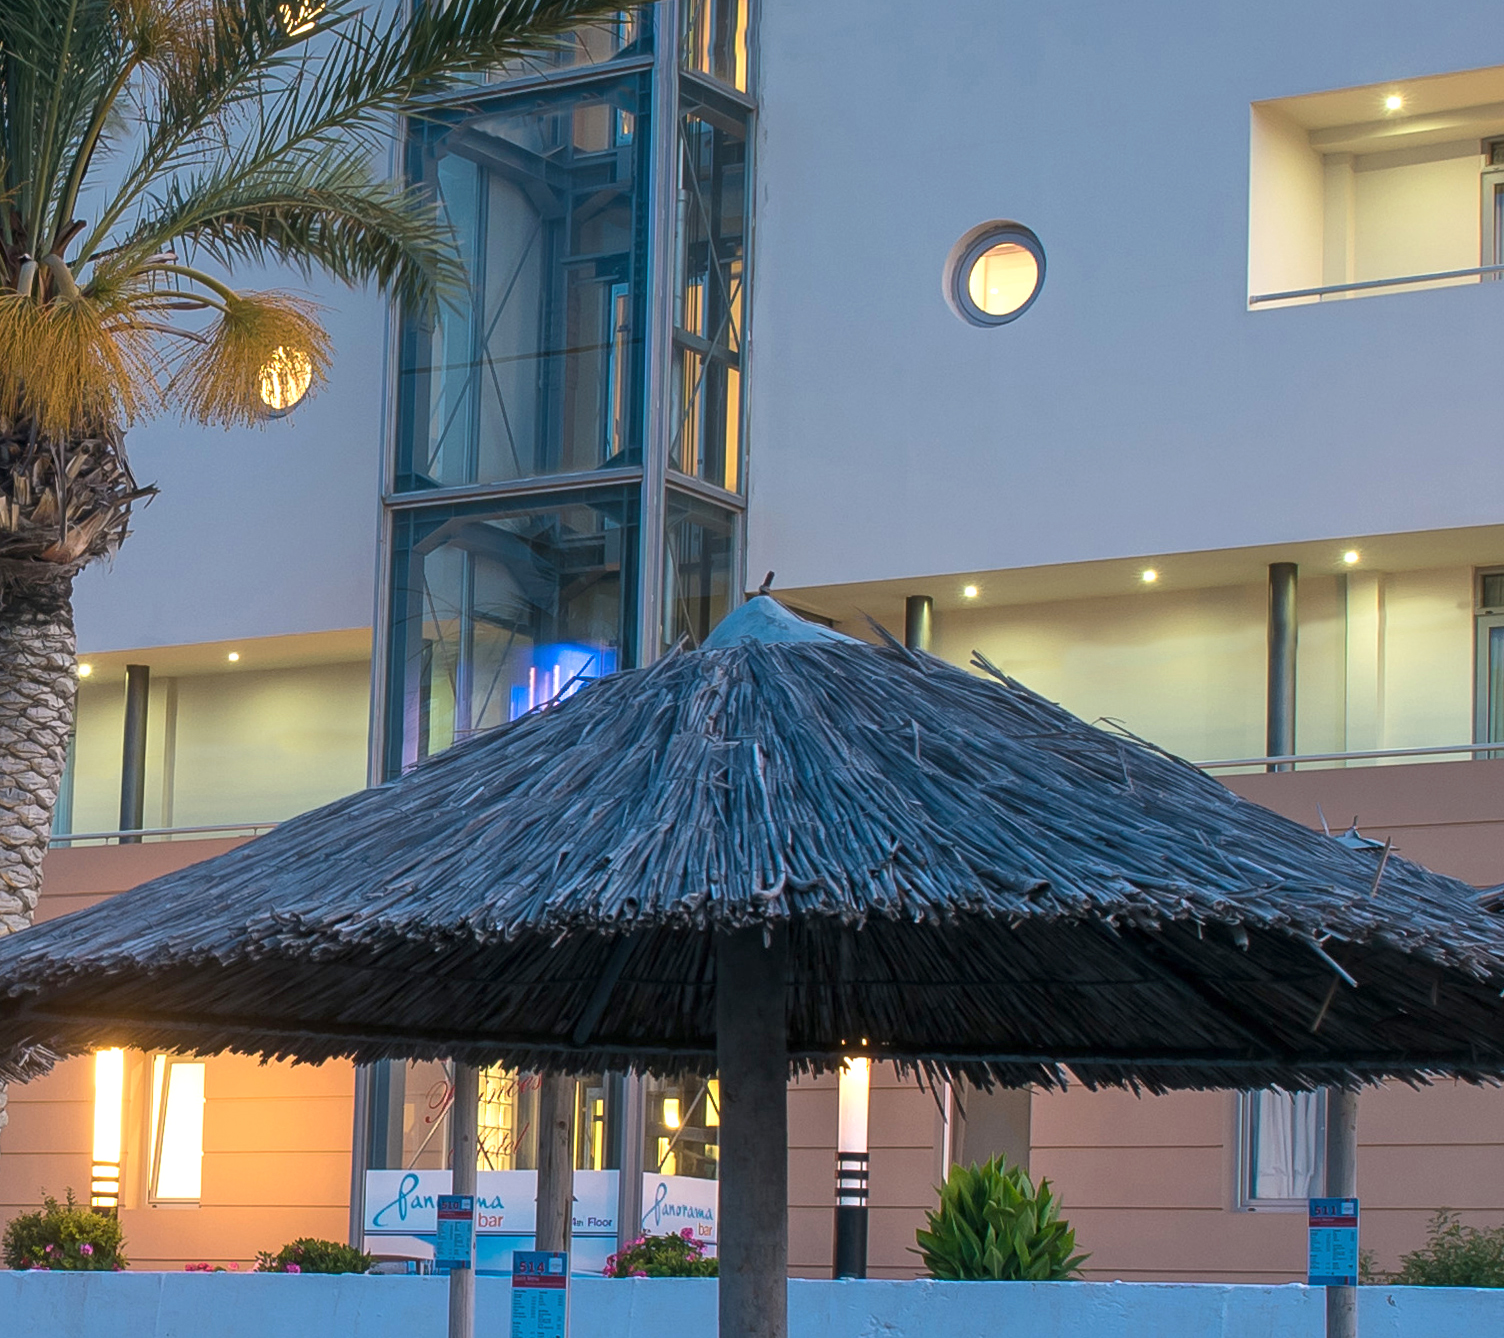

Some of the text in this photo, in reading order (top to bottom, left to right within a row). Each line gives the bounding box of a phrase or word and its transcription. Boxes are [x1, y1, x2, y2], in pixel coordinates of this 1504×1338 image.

[641, 1182, 714, 1231] Panorama
[478, 1212, 504, 1228] bar
[587, 1217, 612, 1227] Floor
[698, 1222, 713, 1237] bar
[519, 1261, 545, 1272] 514
